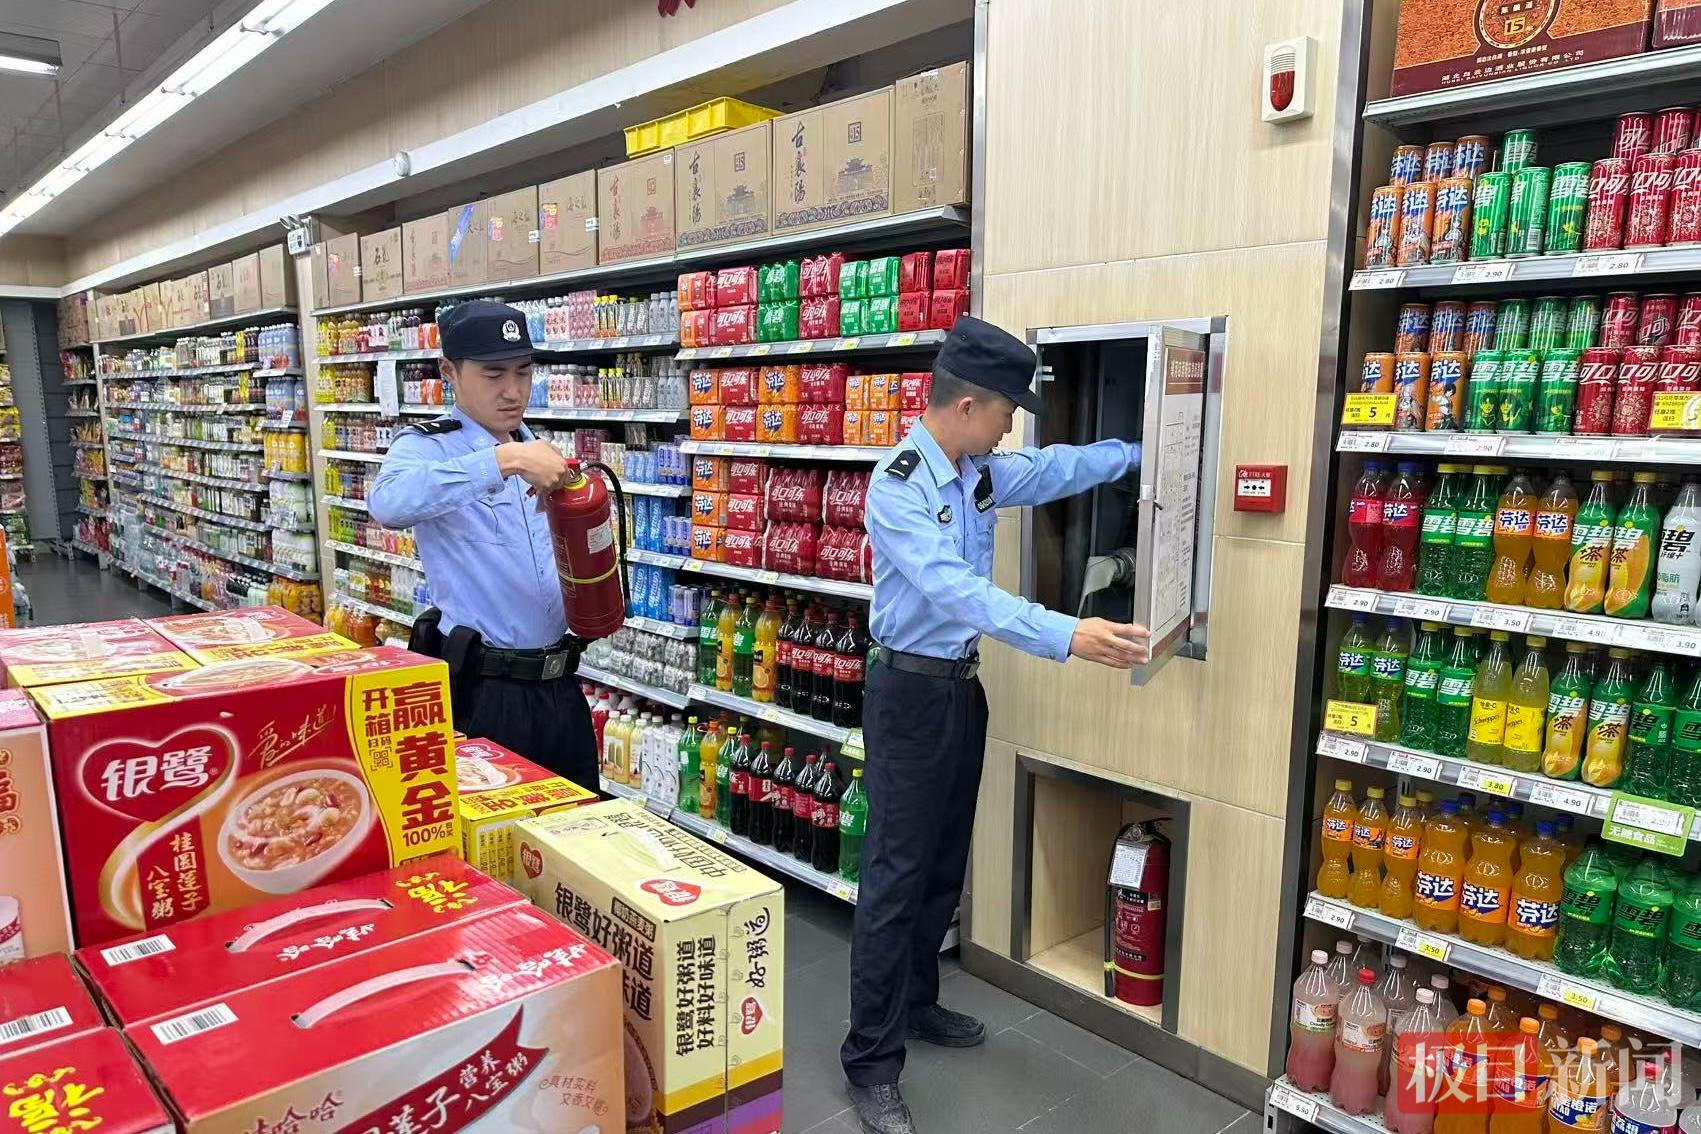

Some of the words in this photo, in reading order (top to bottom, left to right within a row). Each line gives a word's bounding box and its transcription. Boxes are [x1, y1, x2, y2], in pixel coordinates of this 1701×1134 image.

[1505, 19, 1524, 33] 15
[692, 372, 712, 391] 芬达
[720, 371, 750, 387] 可口可乐
[693, 408, 712, 427] 芬达
[725, 410, 756, 424] 可口可乐
[1369, 406, 1377, 418] 5
[695, 459, 714, 477] 芬达
[730, 462, 758, 477] 可口可乐
[771, 485, 806, 502] 可口可乐
[829, 489, 862, 506] 可口可乐
[694, 495, 714, 512] 芬达
[727, 498, 756, 513] 可口可乐
[1383, 502, 1409, 517] 芬达
[1456, 517, 1494, 536] 雪碧
[1500, 510, 1530, 526] 芬达
[1537, 513, 1568, 530] 芬达
[694, 529, 712, 546] 芬达
[724, 534, 754, 549] 可口可乐
[768, 536, 800, 554] 可口可乐
[820, 545, 856, 562] 可口可乐
[1353, 599, 1368, 607] 2.90
[1424, 608, 1440, 616] 2.90
[1504, 619, 1521, 627] 3.50
[1676, 641, 1696, 650] 3.90
[1339, 651, 1364, 667] 芬达
[1373, 657, 1400, 672] 芬达
[1405, 668, 1438, 689] 雪碧
[1350, 715, 1358, 727] 5
[391, 680, 454, 831] 赢黄金
[1344, 749, 1360, 758] 2.90
[100, 745, 213, 802] 银鹭
[1416, 765, 1432, 774] 2.90
[1487, 781, 1504, 790] 3.80
[1564, 798, 1582, 808] 4.90
[1327, 819, 1346, 831] 芬达
[402, 825, 446, 847] 100%
[1391, 836, 1414, 848] 芬达
[169, 831, 202, 912] 桂圆莲子
[1417, 871, 1454, 896] 芬达
[147, 865, 175, 920] 八宝粥
[1462, 881, 1500, 908] 芬达
[1330, 914, 1345, 924] 2.90
[1517, 898, 1558, 924] 芬达
[555, 881, 655, 981] 银鹭好粥道
[1424, 944, 1440, 954] 3.50
[675, 937, 696, 1057] 银鹭好粥道
[696, 933, 716, 1051] 好料好味道
[1571, 992, 1588, 1003] 3.50
[459, 1050, 500, 1087] 营养
[465, 1054, 528, 1112] 八宝粥
[549, 1076, 599, 1094] 真材实料
